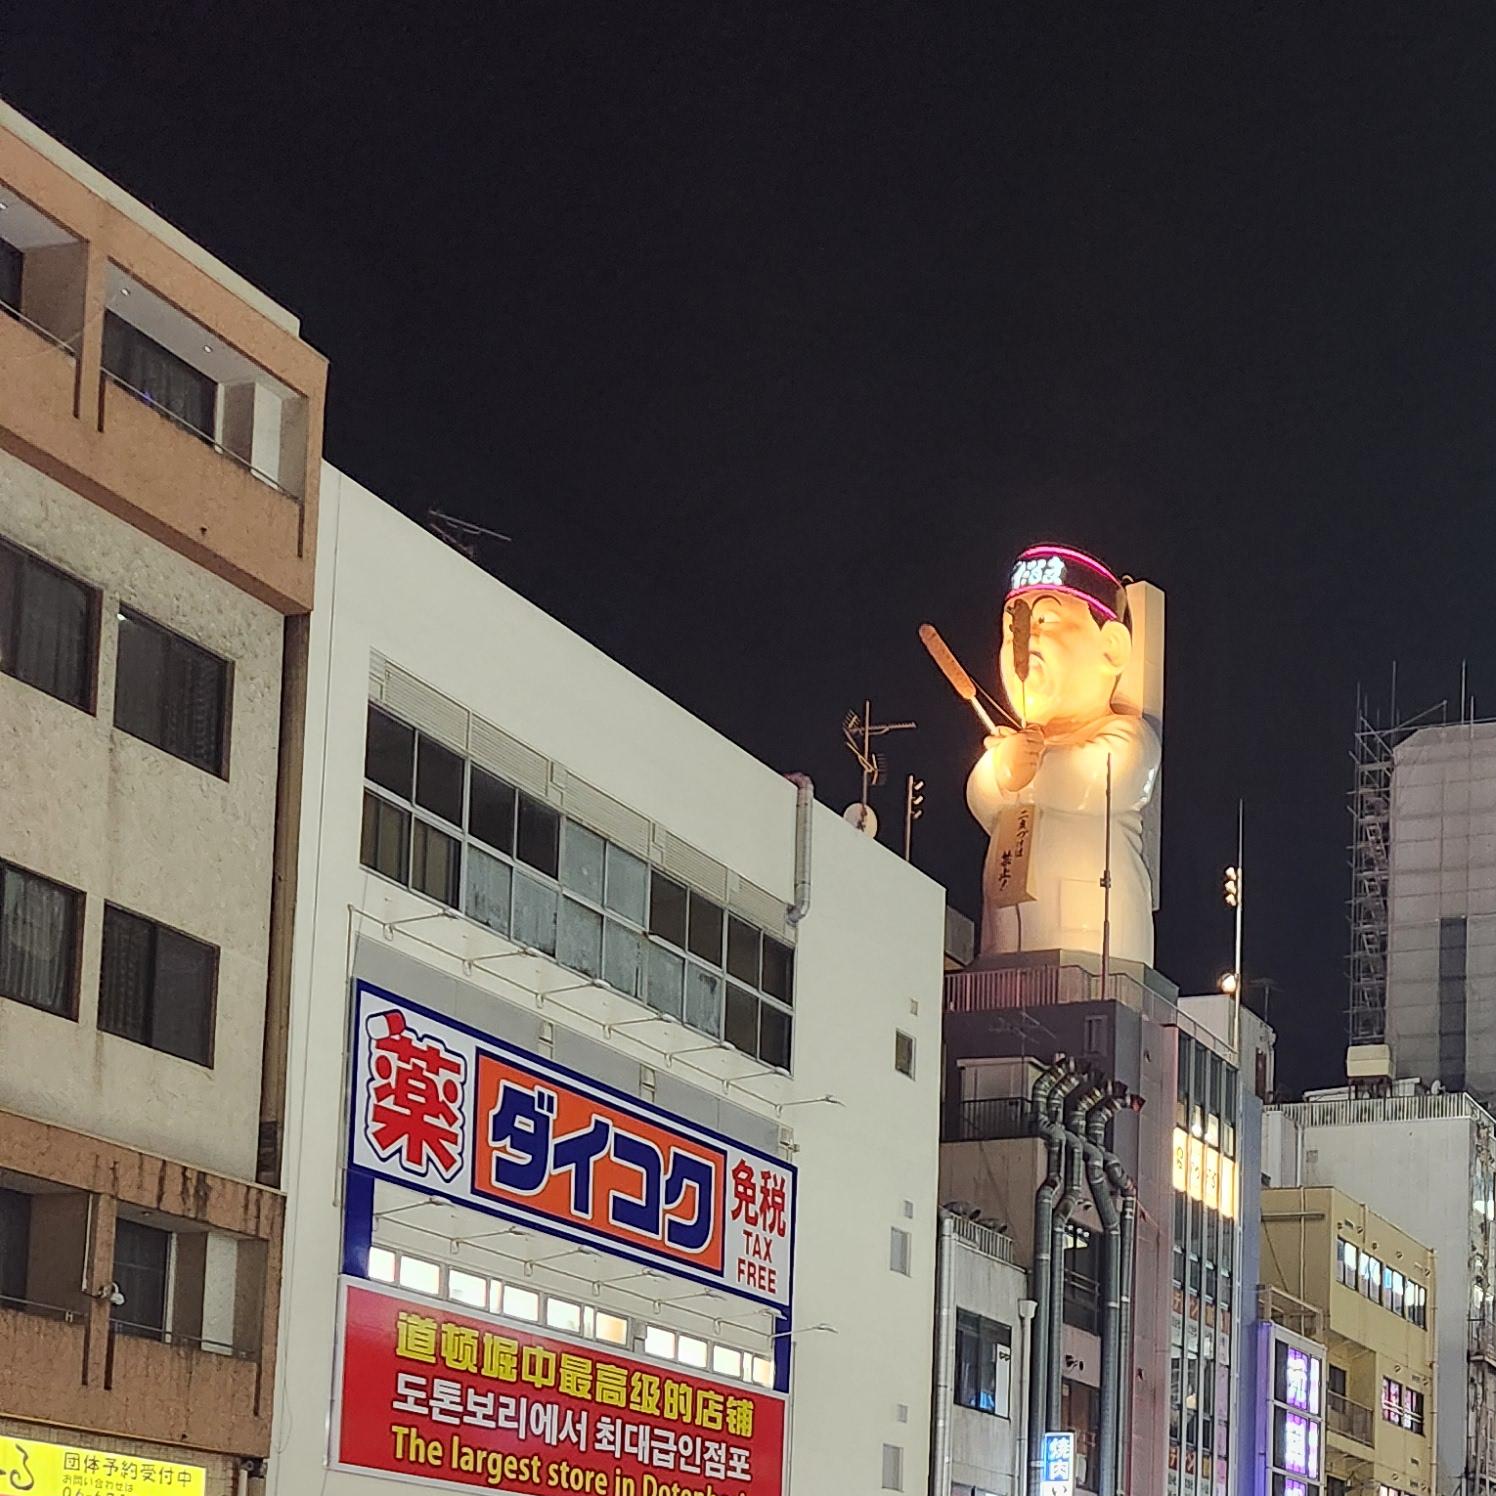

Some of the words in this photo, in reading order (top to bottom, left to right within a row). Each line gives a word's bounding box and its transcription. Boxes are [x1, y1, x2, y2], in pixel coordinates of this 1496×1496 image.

[367, 1008, 466, 1181] 薬
[490, 1081, 714, 1254] ダイコク
[731, 1159, 787, 1238] 免税
[743, 1231, 773, 1262] TAX
[737, 1260, 777, 1295] FREE
[392, 1372, 589, 1451] 도톤보리에서
[595, 1417, 752, 1482] 최대급인점포
[63, 1452, 192, 1488] 団体予約受付中
[392, 1425, 441, 1466] The
[451, 1446, 541, 1488] largest
[1049, 1436, 1069, 1480] 焼肉
[62, 1474, 134, 1493] お問い合わせは
